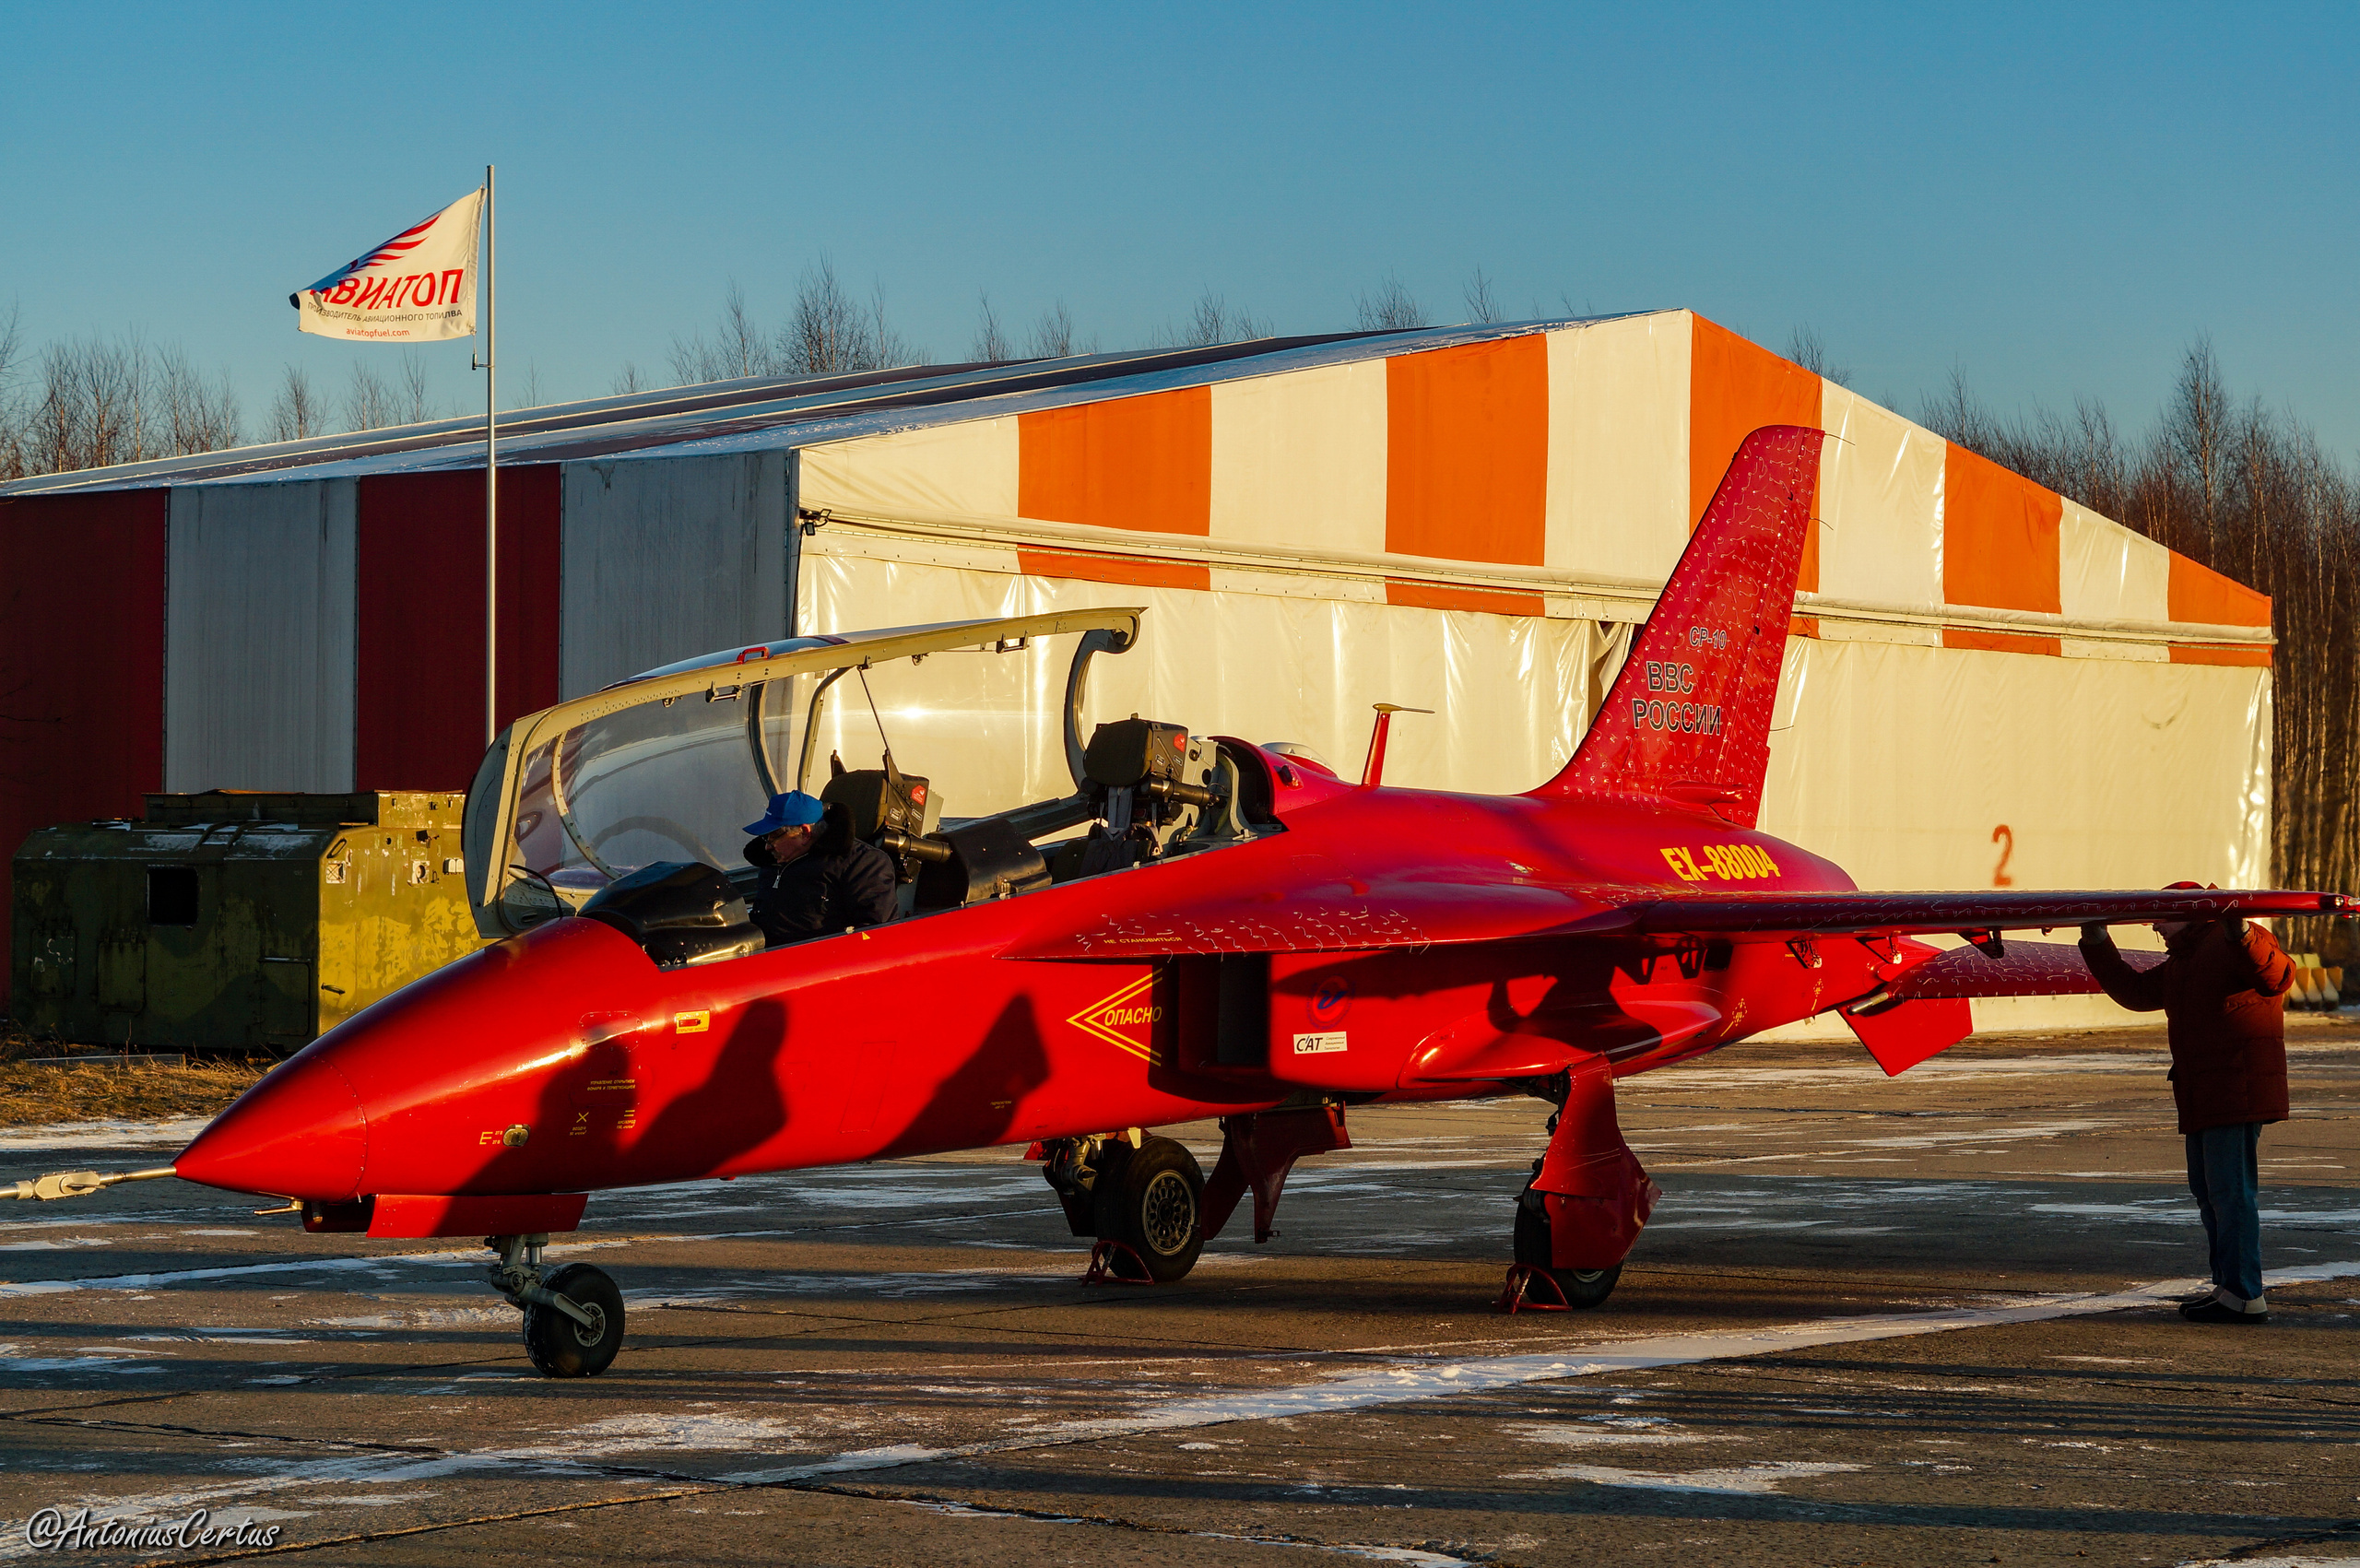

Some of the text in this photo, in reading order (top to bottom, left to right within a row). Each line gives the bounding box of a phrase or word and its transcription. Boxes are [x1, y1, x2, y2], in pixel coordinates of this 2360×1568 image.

[346, 327, 410, 338] aviatopfuel.com
[1689, 626, 1728, 650] СР-10
[1646, 661, 1693, 694] ВВС
[1632, 699, 1721, 736] РОССИИ
[1659, 844, 1781, 881] EX-88004
[1991, 824, 2012, 887] 2
[1104, 1006, 1162, 1026] ОПАСНО
